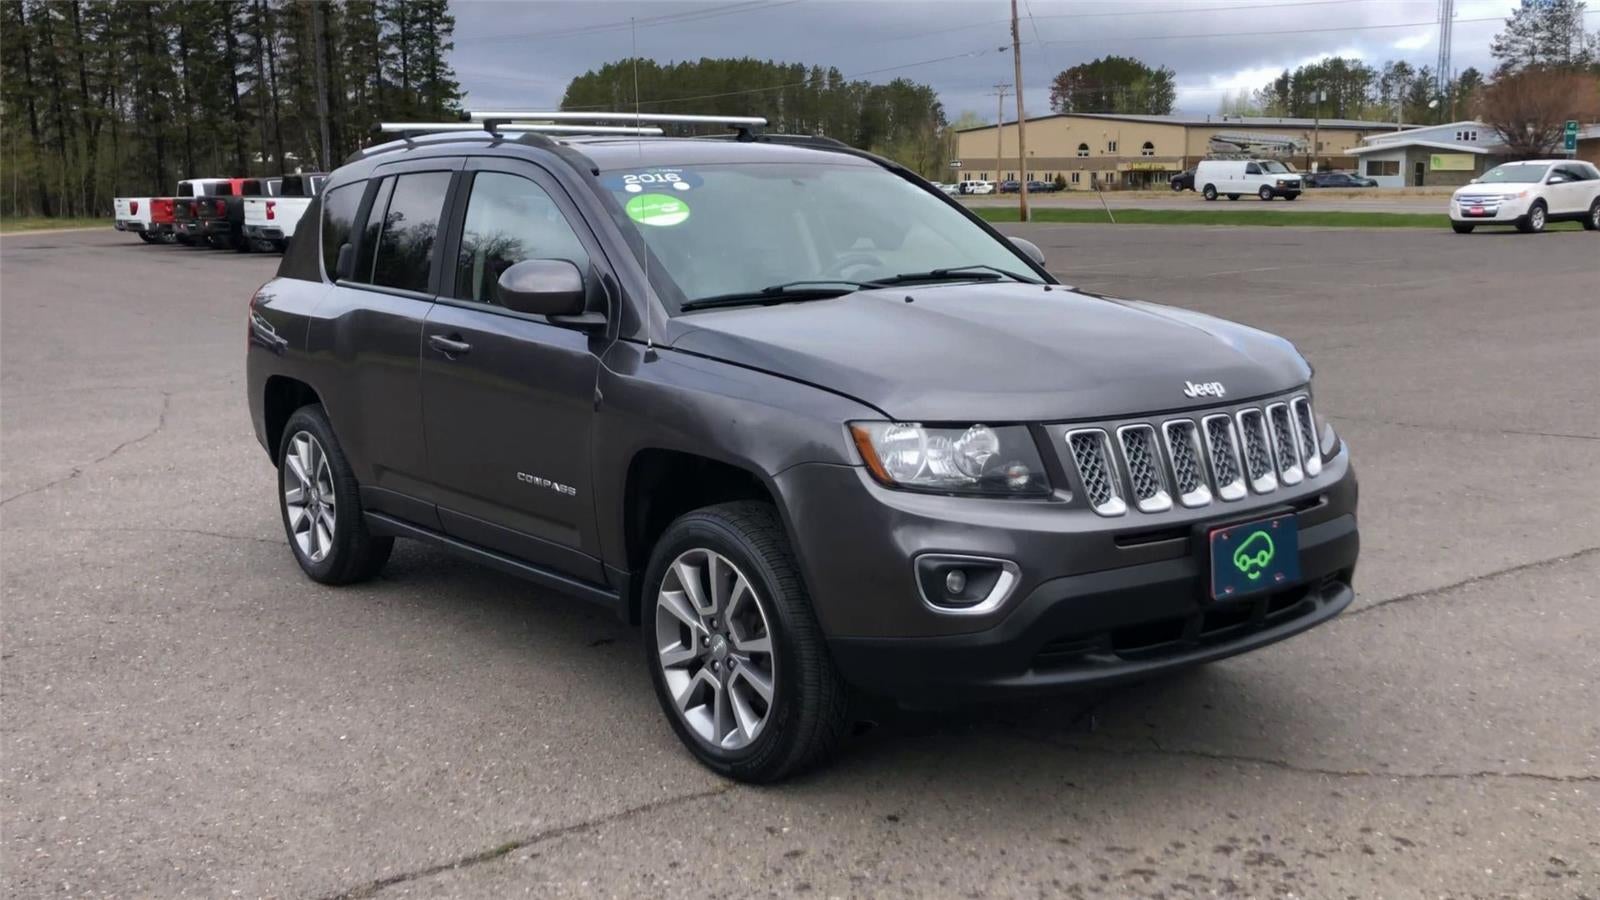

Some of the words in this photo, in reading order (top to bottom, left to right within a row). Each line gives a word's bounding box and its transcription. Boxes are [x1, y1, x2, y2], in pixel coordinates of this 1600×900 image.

[623, 173, 682, 184] 2016
[1183, 381, 1226, 398] Jeep
[516, 471, 577, 497] COMPASS
